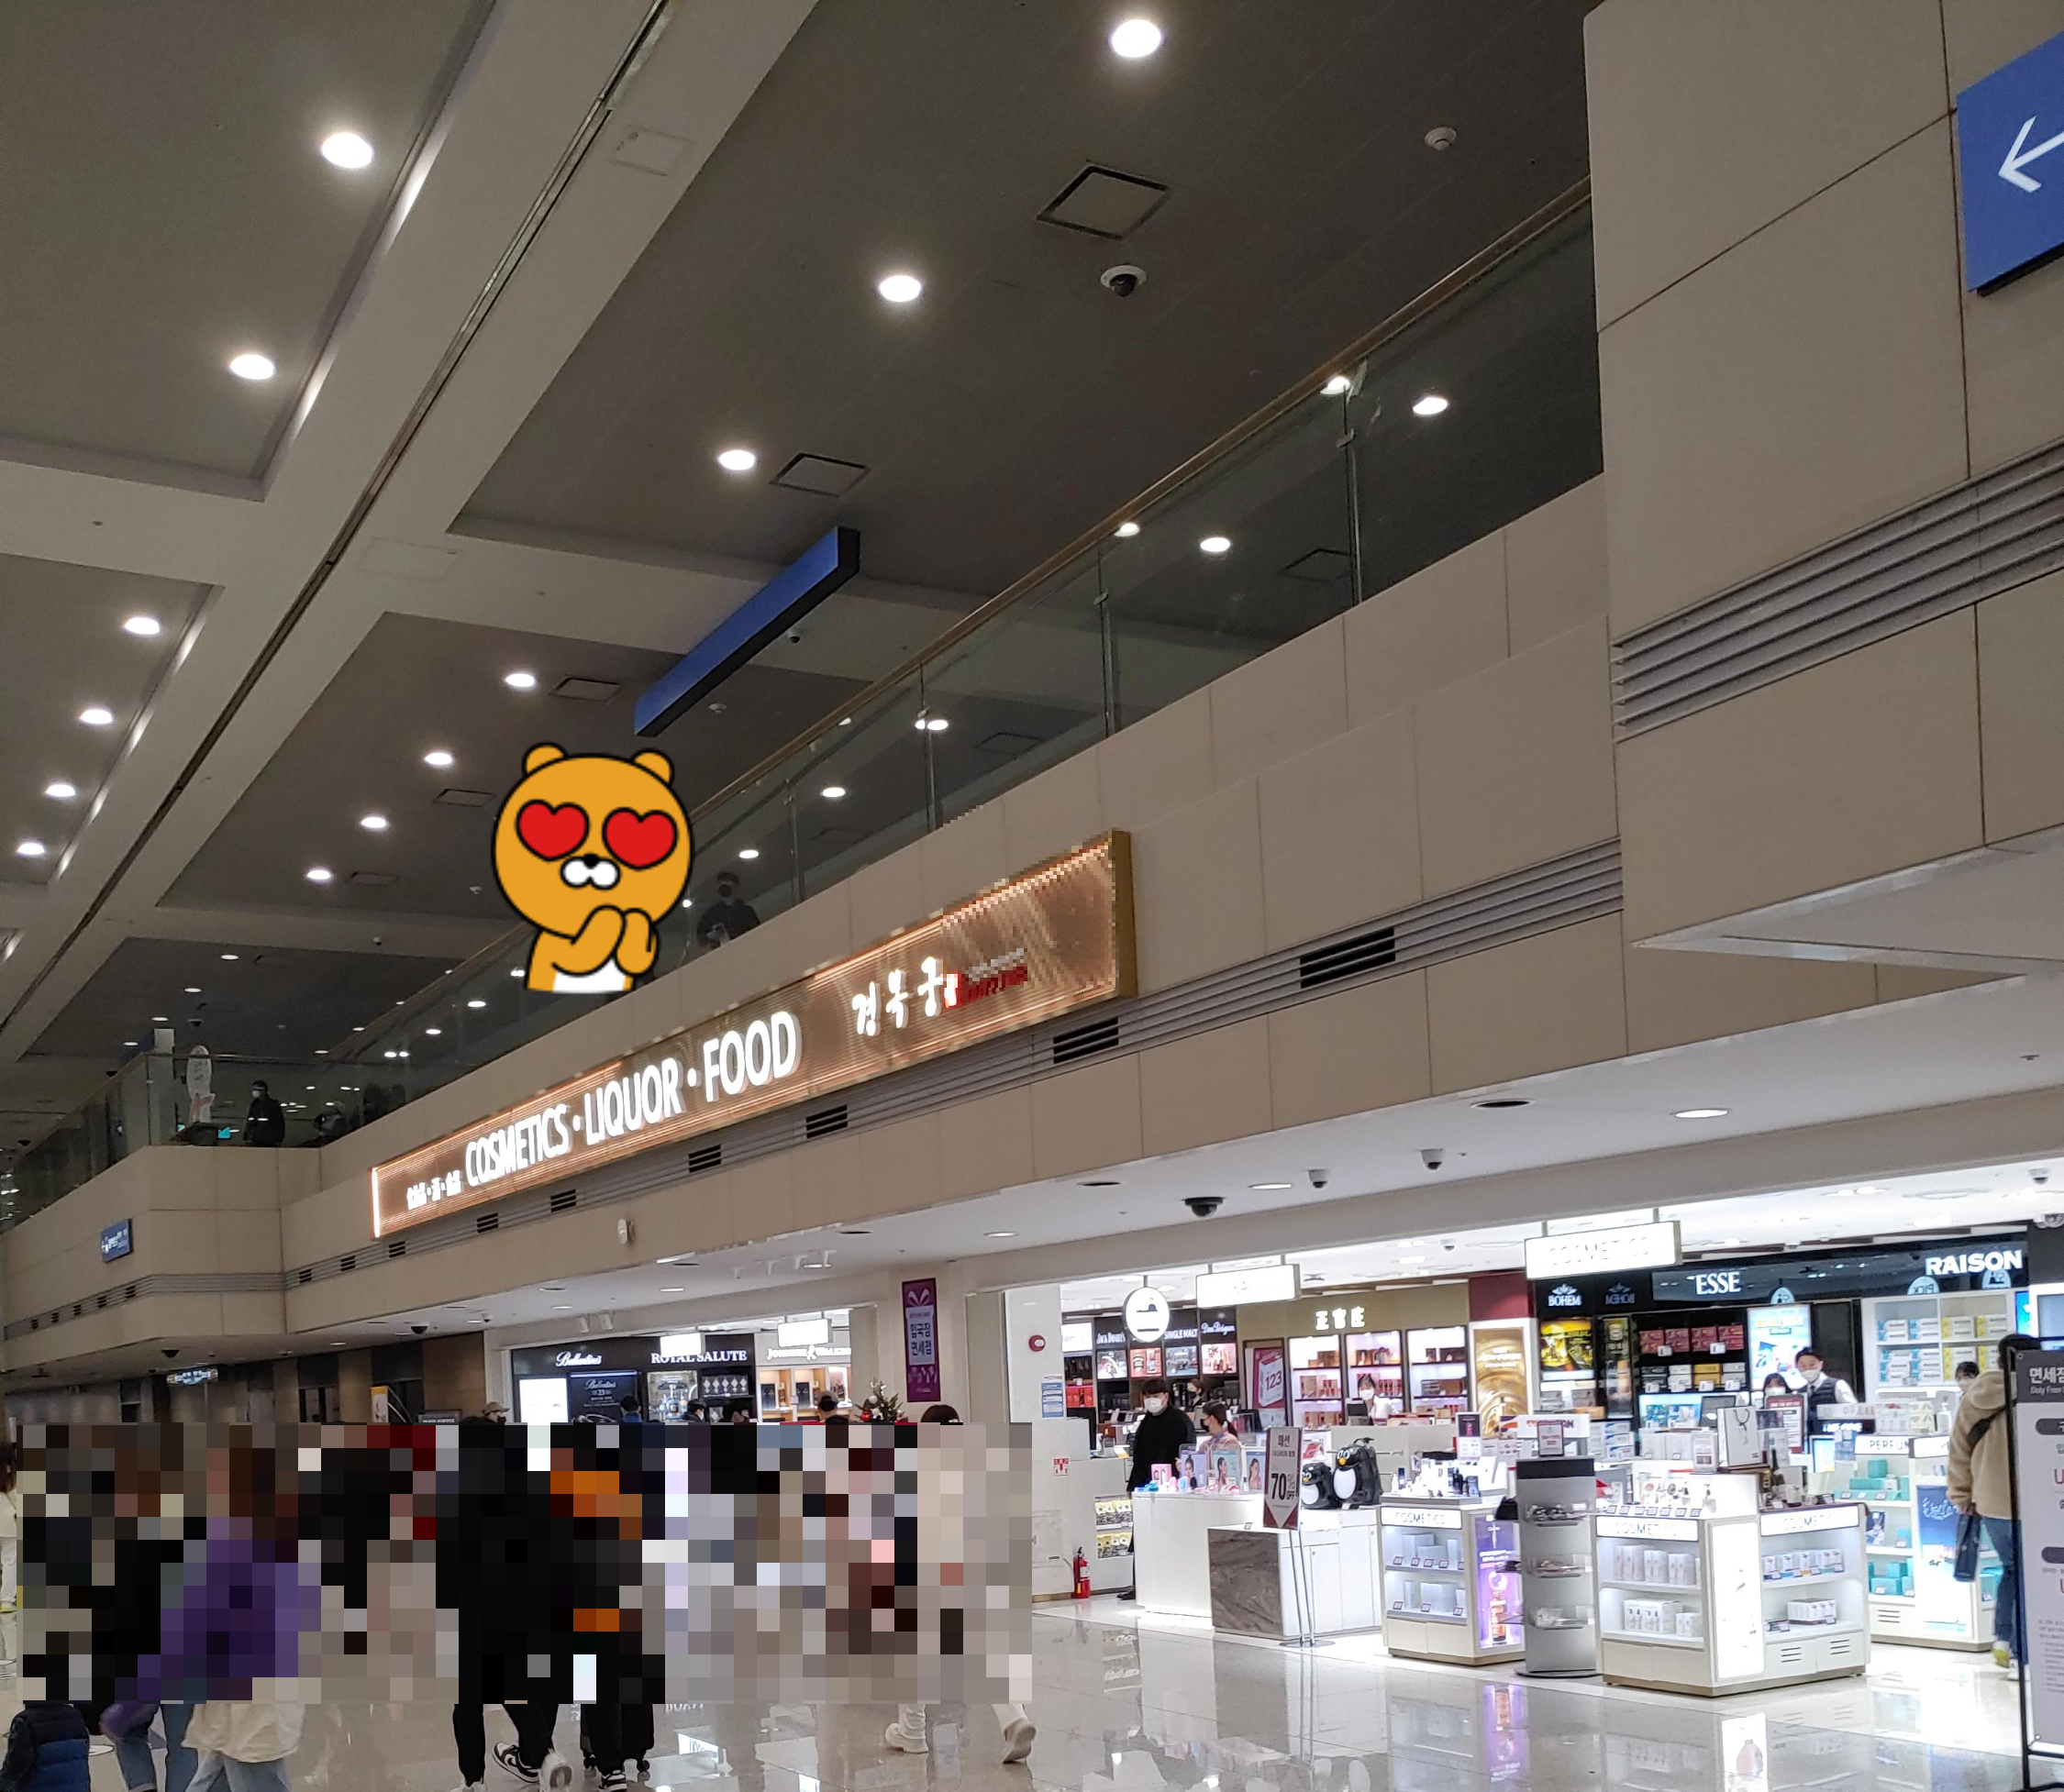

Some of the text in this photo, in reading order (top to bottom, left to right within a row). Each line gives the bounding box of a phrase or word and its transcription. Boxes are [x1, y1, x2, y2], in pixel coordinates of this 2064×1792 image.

[465, 1011, 802, 1187] COSMETICS LIQUOR FOOD
[1925, 1250, 2023, 1276] RAISON
[1695, 1271, 1741, 1295] ESSE
[1548, 1294, 1581, 1307] BOHEM
[911, 1340, 932, 1355] 면세점
[696, 1350, 748, 1363] SALUTE
[1265, 1371, 1282, 1390] 123
[1395, 1512, 1446, 1524] COSMETCS
